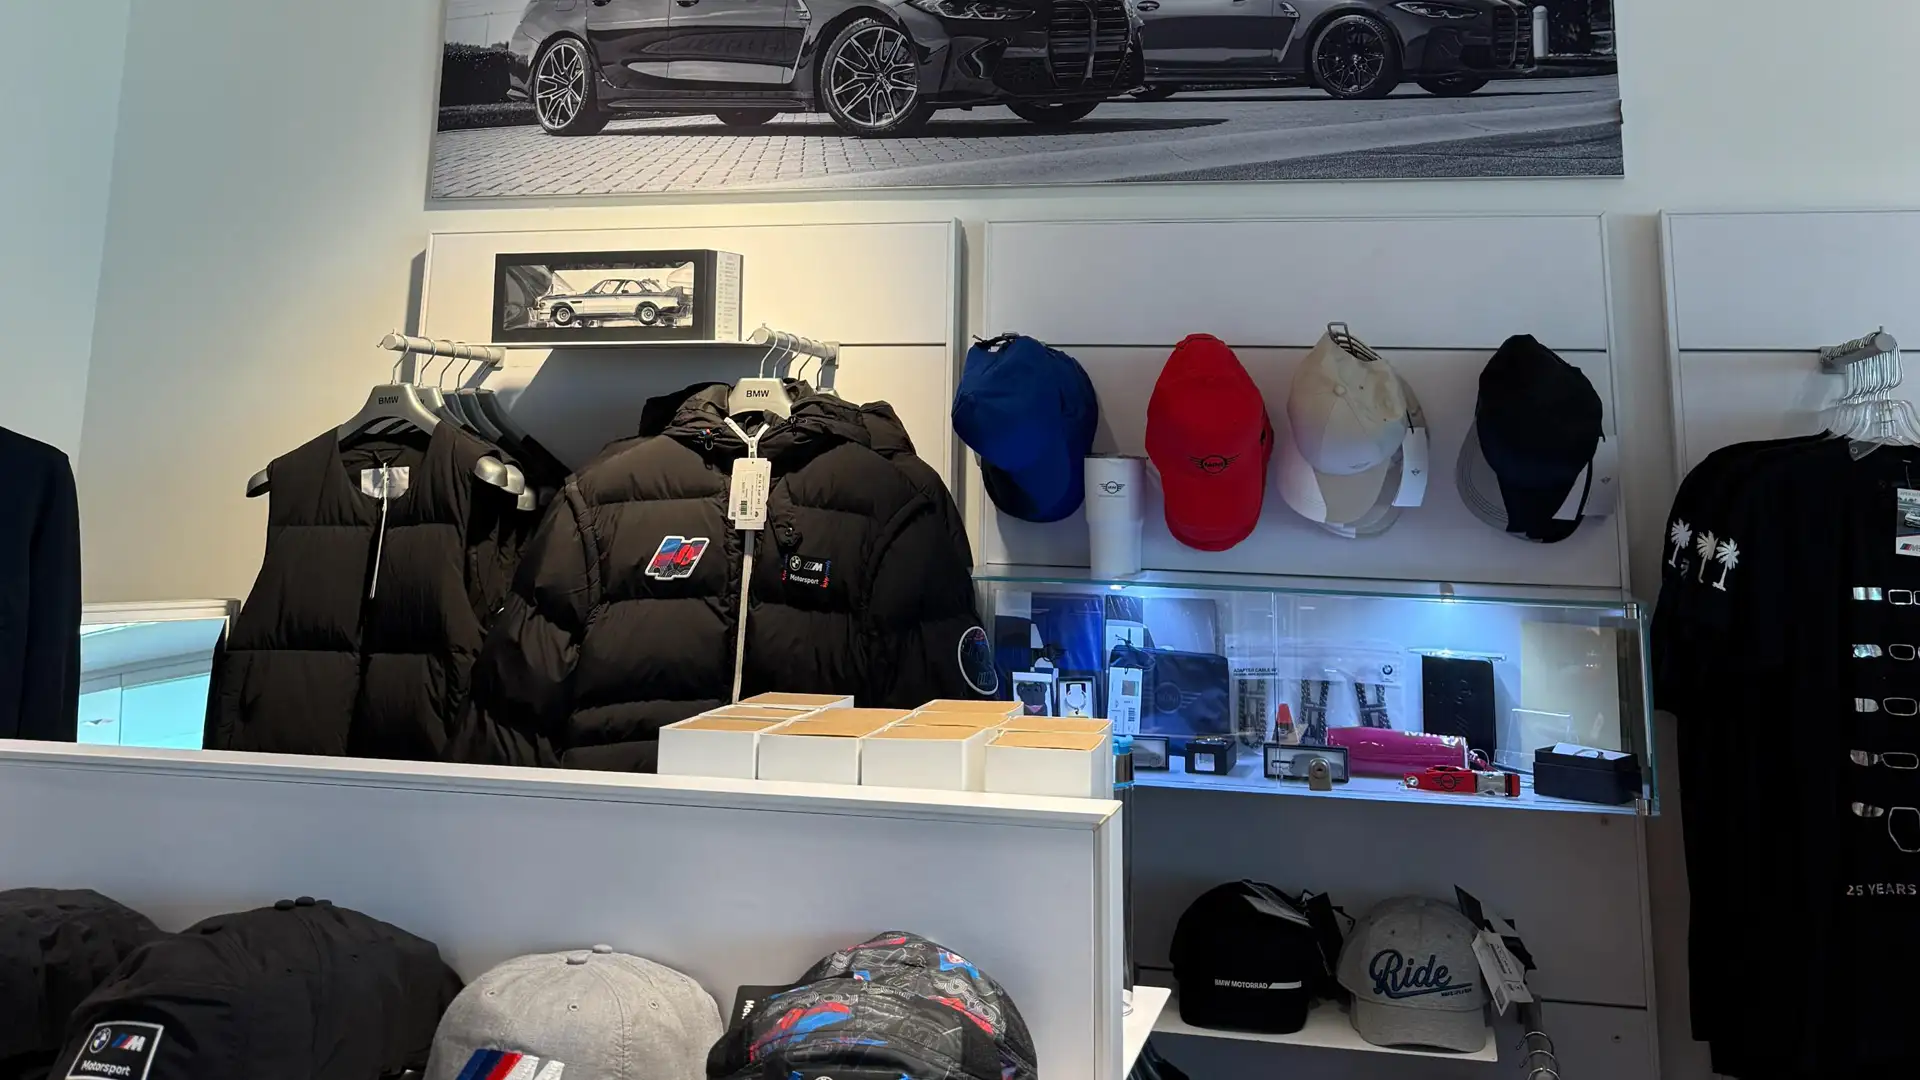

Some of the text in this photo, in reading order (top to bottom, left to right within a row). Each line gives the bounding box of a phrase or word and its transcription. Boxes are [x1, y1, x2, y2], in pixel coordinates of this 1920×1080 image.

[746, 390, 770, 398] BMW
[378, 396, 399, 405] BMW
[790, 574, 819, 585] Motorsport
[1846, 883, 1917, 896] 25 YEARS
[1369, 949, 1458, 998] Ride
[1214, 979, 1268, 989] BMW MOTORRAD
[742, 1000, 755, 1020] Mo
[80, 1060, 131, 1077] Motorsport
